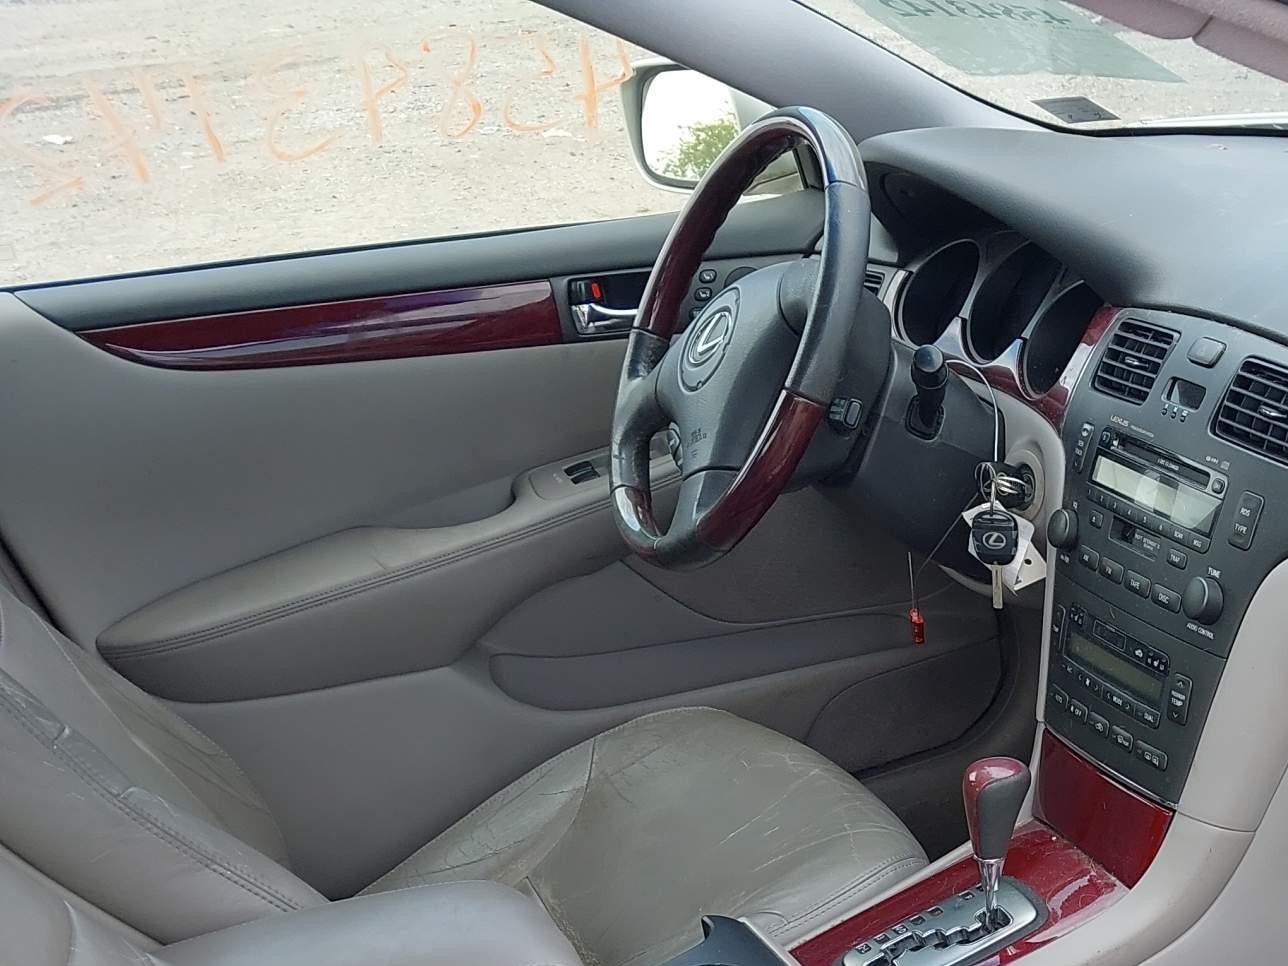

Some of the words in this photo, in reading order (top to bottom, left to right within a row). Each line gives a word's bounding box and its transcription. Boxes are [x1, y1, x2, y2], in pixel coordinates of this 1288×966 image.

[1235, 523, 1248, 535] TYPE
[1208, 566, 1221, 579] TUNE
[1158, 592, 1170, 604] DISC
